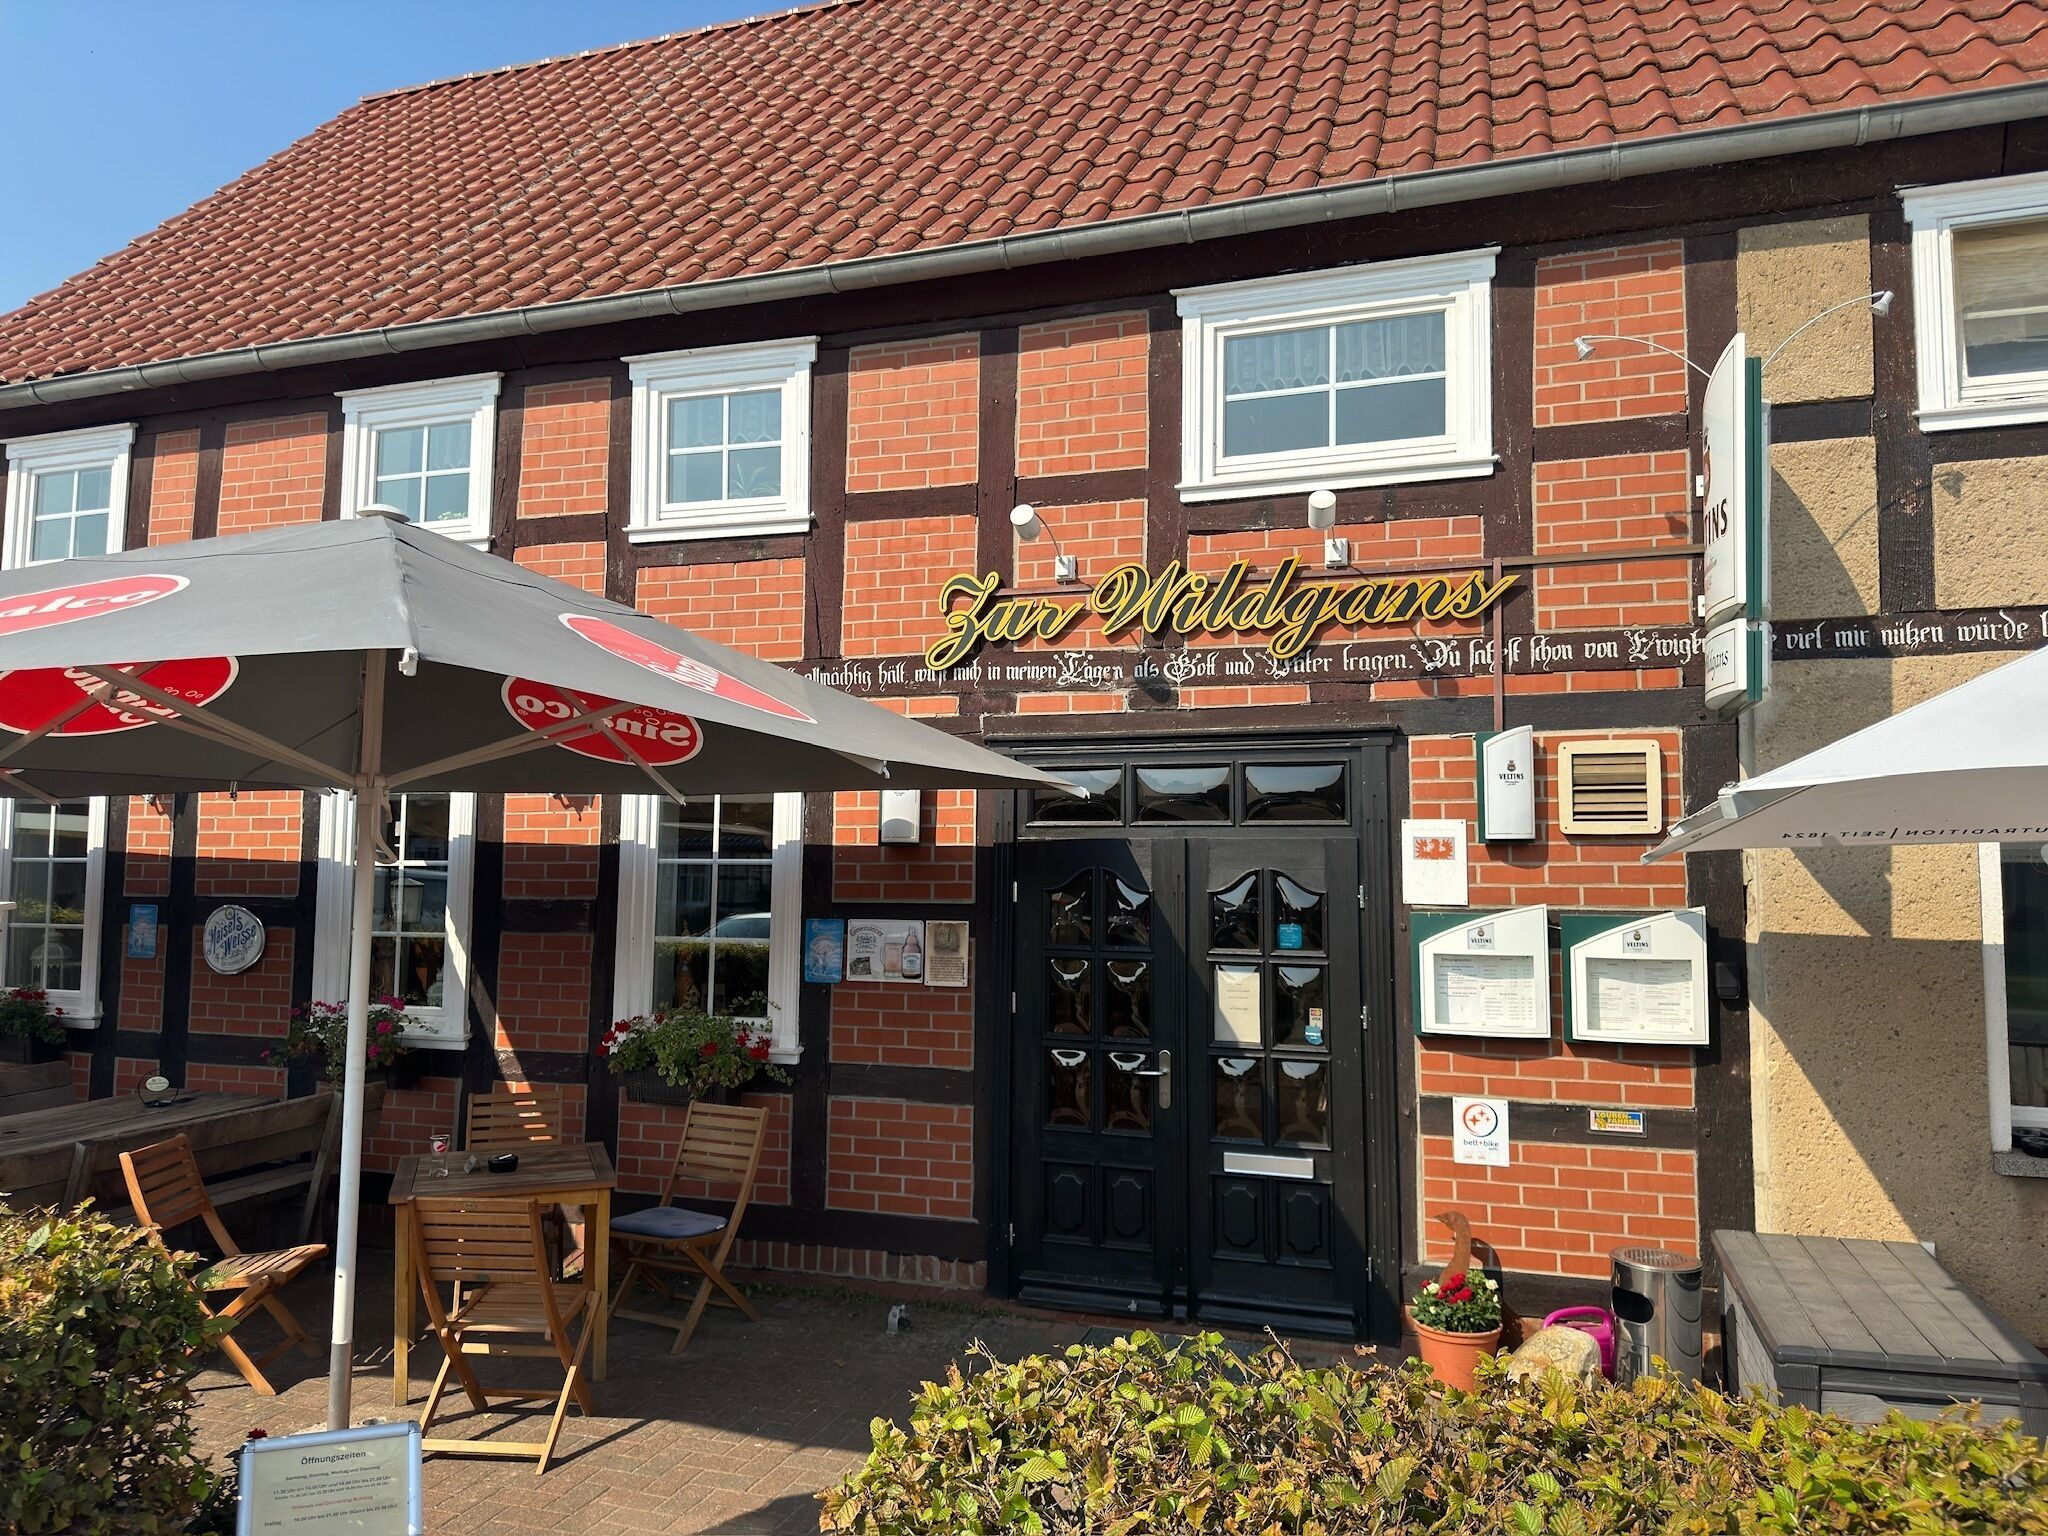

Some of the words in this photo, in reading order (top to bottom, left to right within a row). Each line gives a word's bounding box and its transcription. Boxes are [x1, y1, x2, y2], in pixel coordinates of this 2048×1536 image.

[925, 571, 1085, 671] Zur
[1090, 553, 1521, 659] Wildgans
[953, 656, 982, 688] mich
[987, 661, 1001, 681] in
[1006, 660, 1057, 680] meinen
[1135, 658, 1160, 678] als
[1225, 650, 1255, 676] und
[1584, 638, 1618, 659] von
[1786, 621, 1826, 650] viel
[1834, 624, 1869, 646] mir
[1957, 609, 2029, 642] würde
[301, 1451, 366, 1465] Öffnungszeiten
